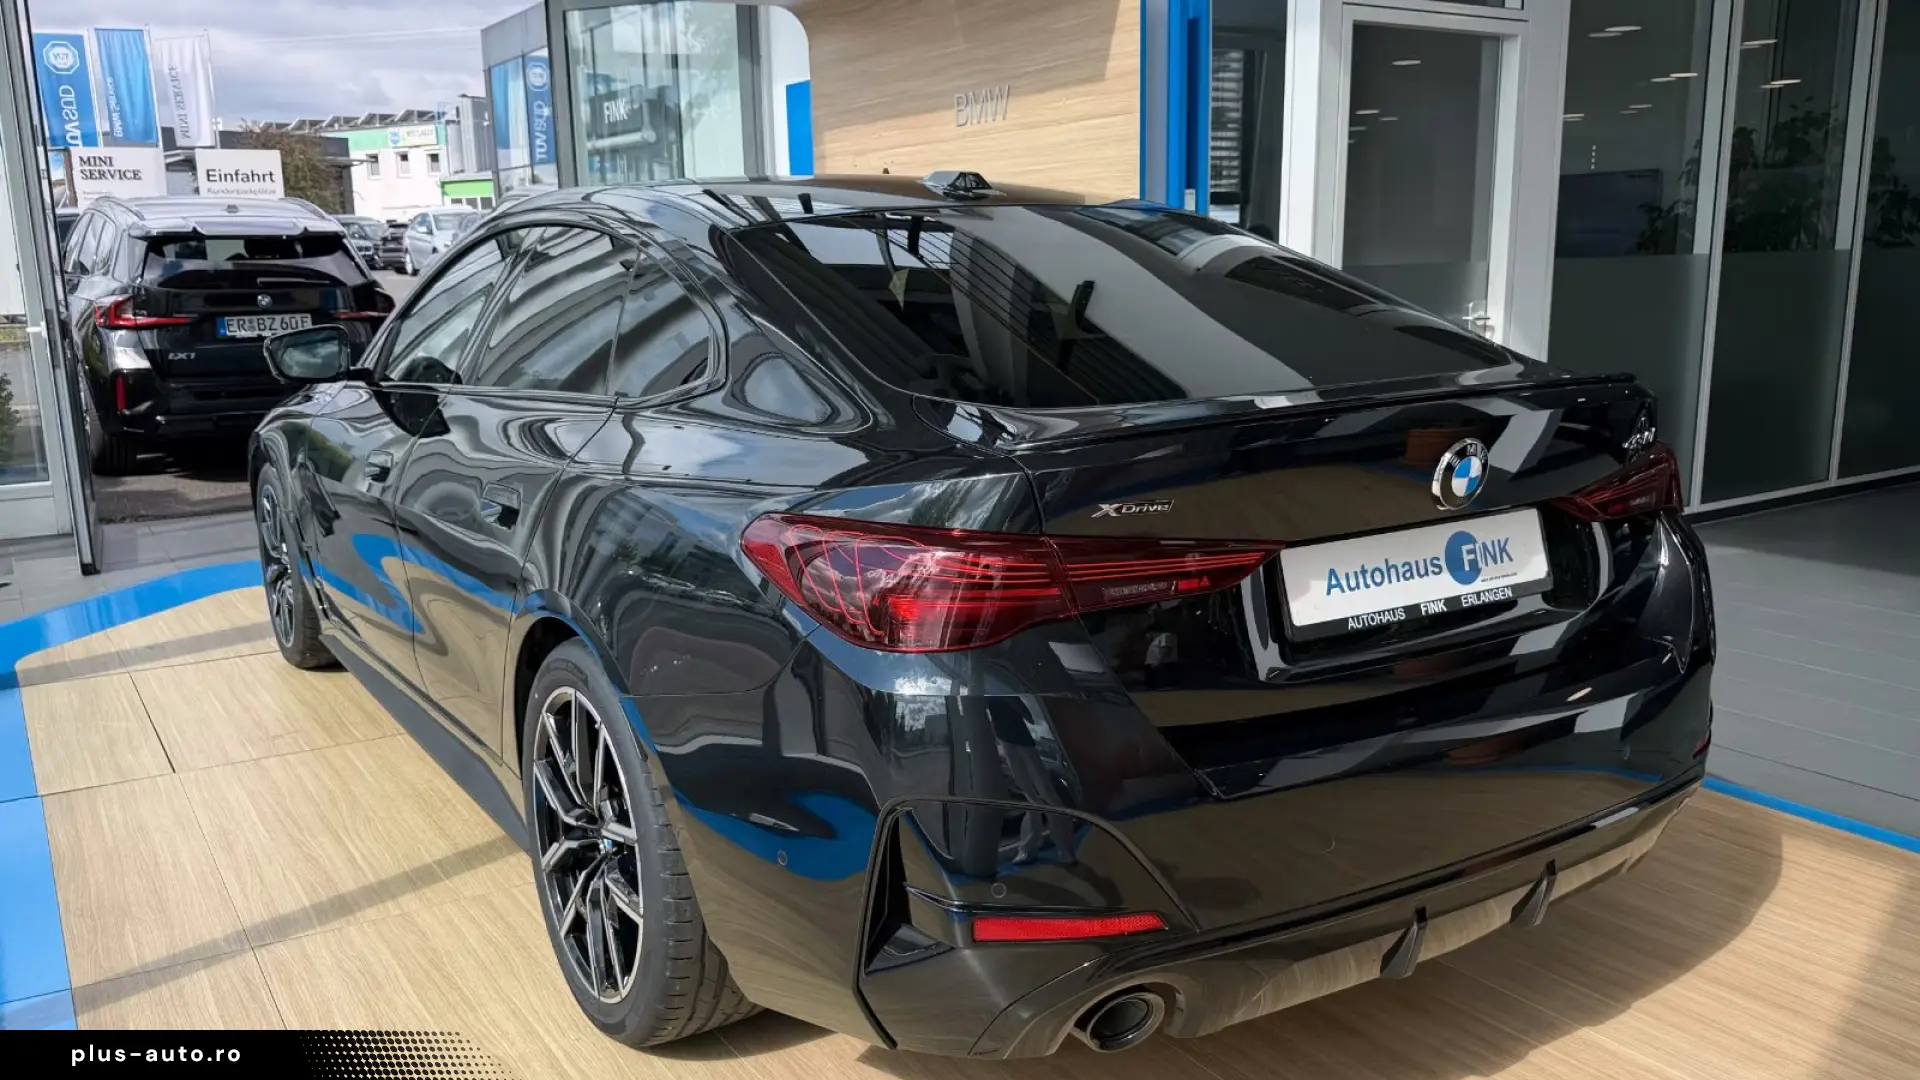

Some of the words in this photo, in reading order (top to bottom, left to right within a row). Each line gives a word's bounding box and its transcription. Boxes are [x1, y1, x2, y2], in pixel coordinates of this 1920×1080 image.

[955, 84, 1010, 128] BMW
[79, 155, 114, 167] MINI
[80, 168, 142, 181] SERVICE
[206, 168, 276, 183] Einfahrt
[226, 318, 248, 333] ER
[257, 317, 277, 332] BZ
[1325, 555, 1443, 596] Autohaus
[1460, 537, 1514, 572] FINK
[1348, 608, 1406, 630] AUTOHAUS
[1420, 600, 1447, 616] FINK
[1461, 587, 1513, 607] ERLANGEN
